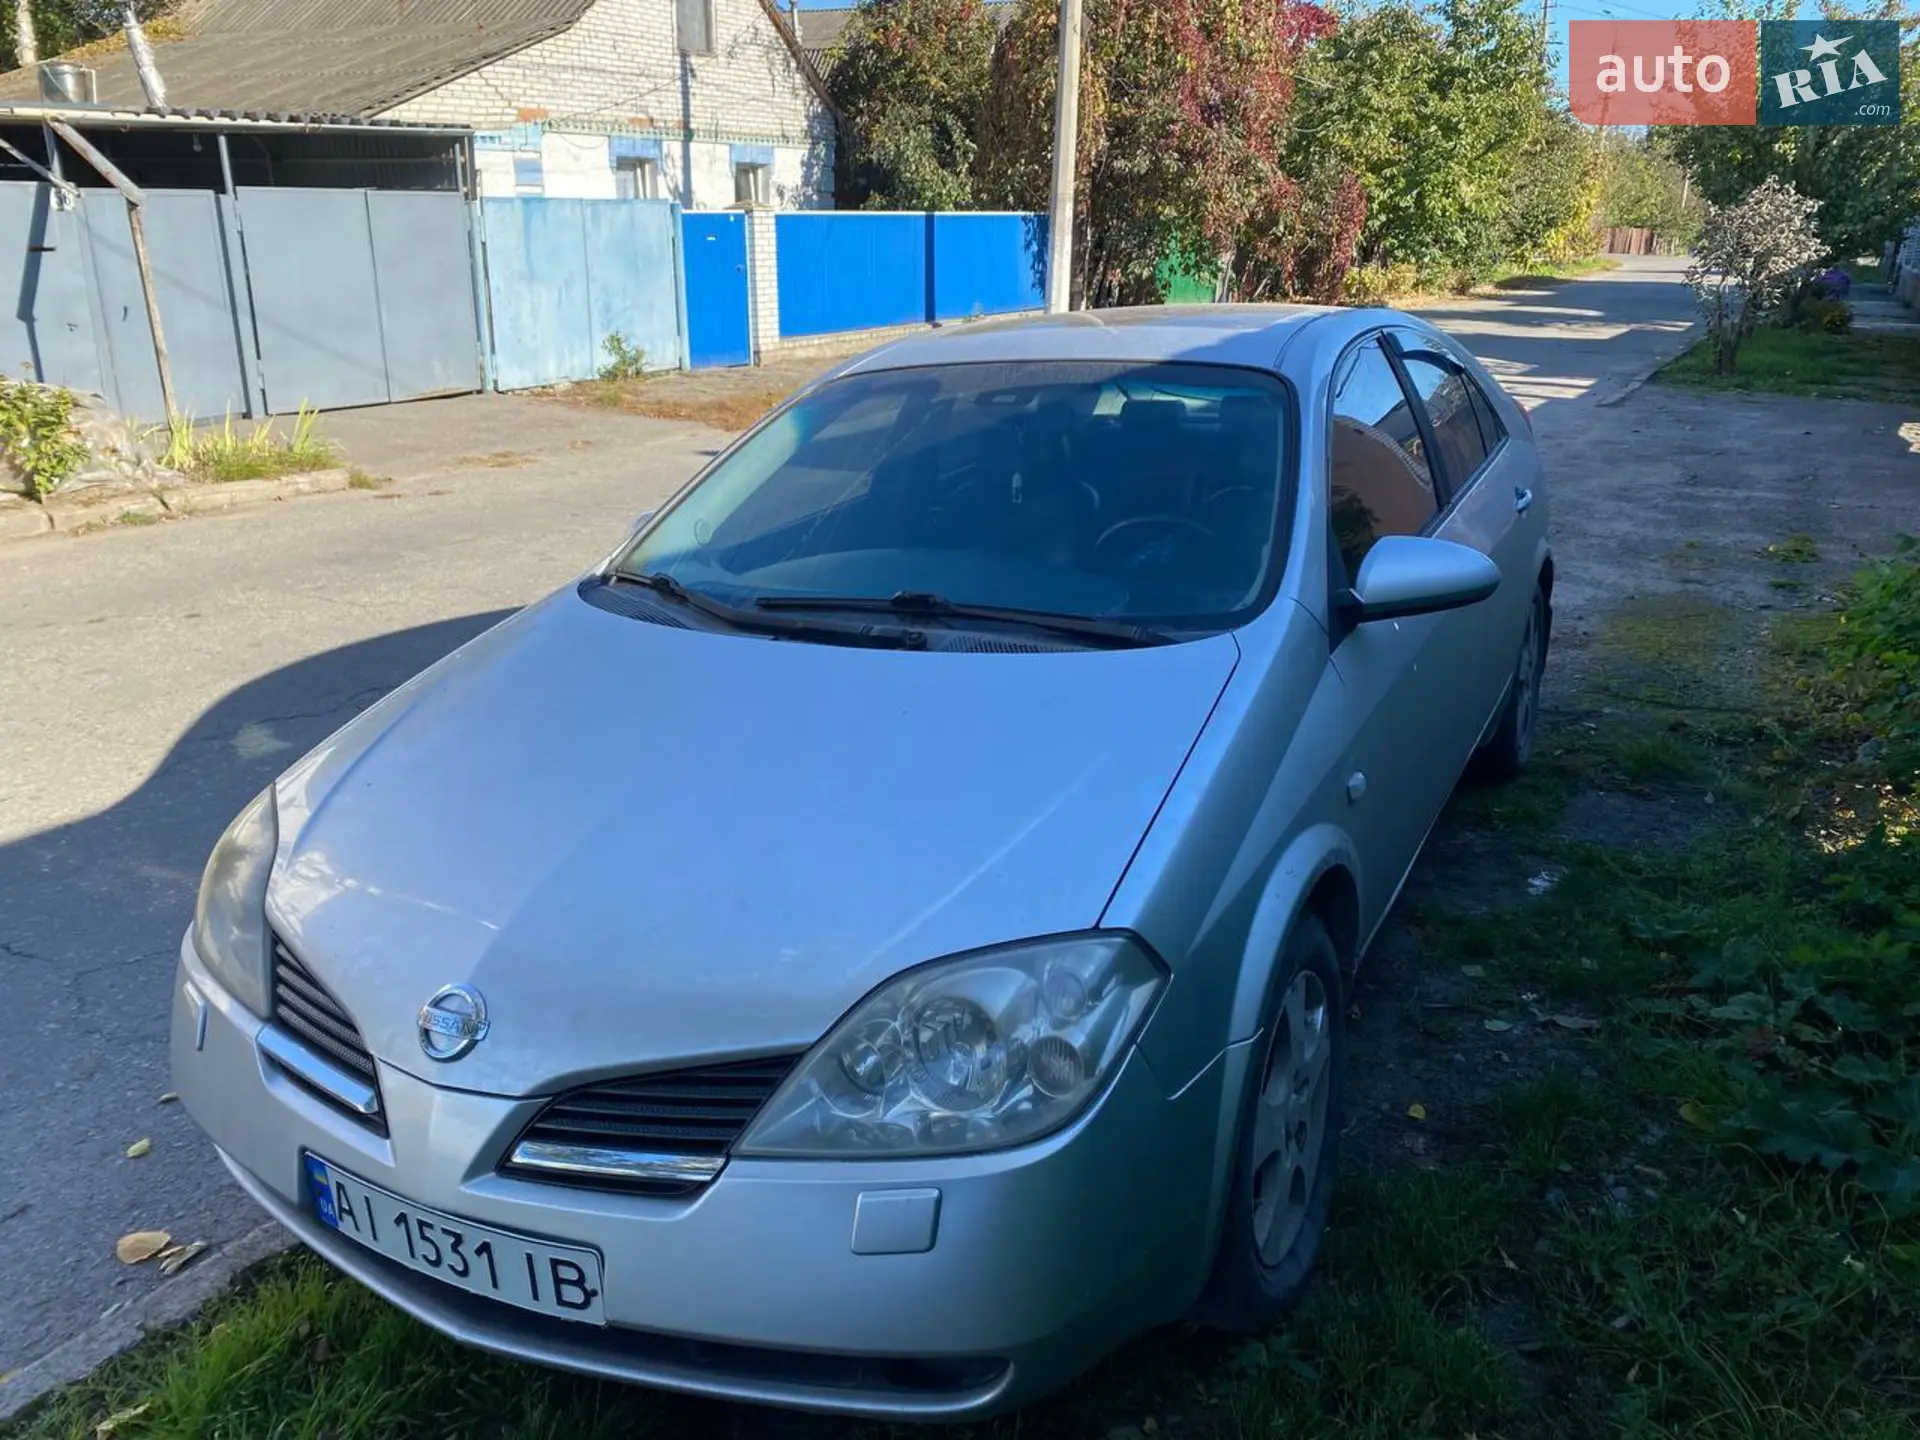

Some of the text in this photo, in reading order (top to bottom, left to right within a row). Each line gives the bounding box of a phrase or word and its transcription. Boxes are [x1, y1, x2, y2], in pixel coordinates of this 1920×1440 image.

[335, 1180, 591, 1311] AI 1531 IB
